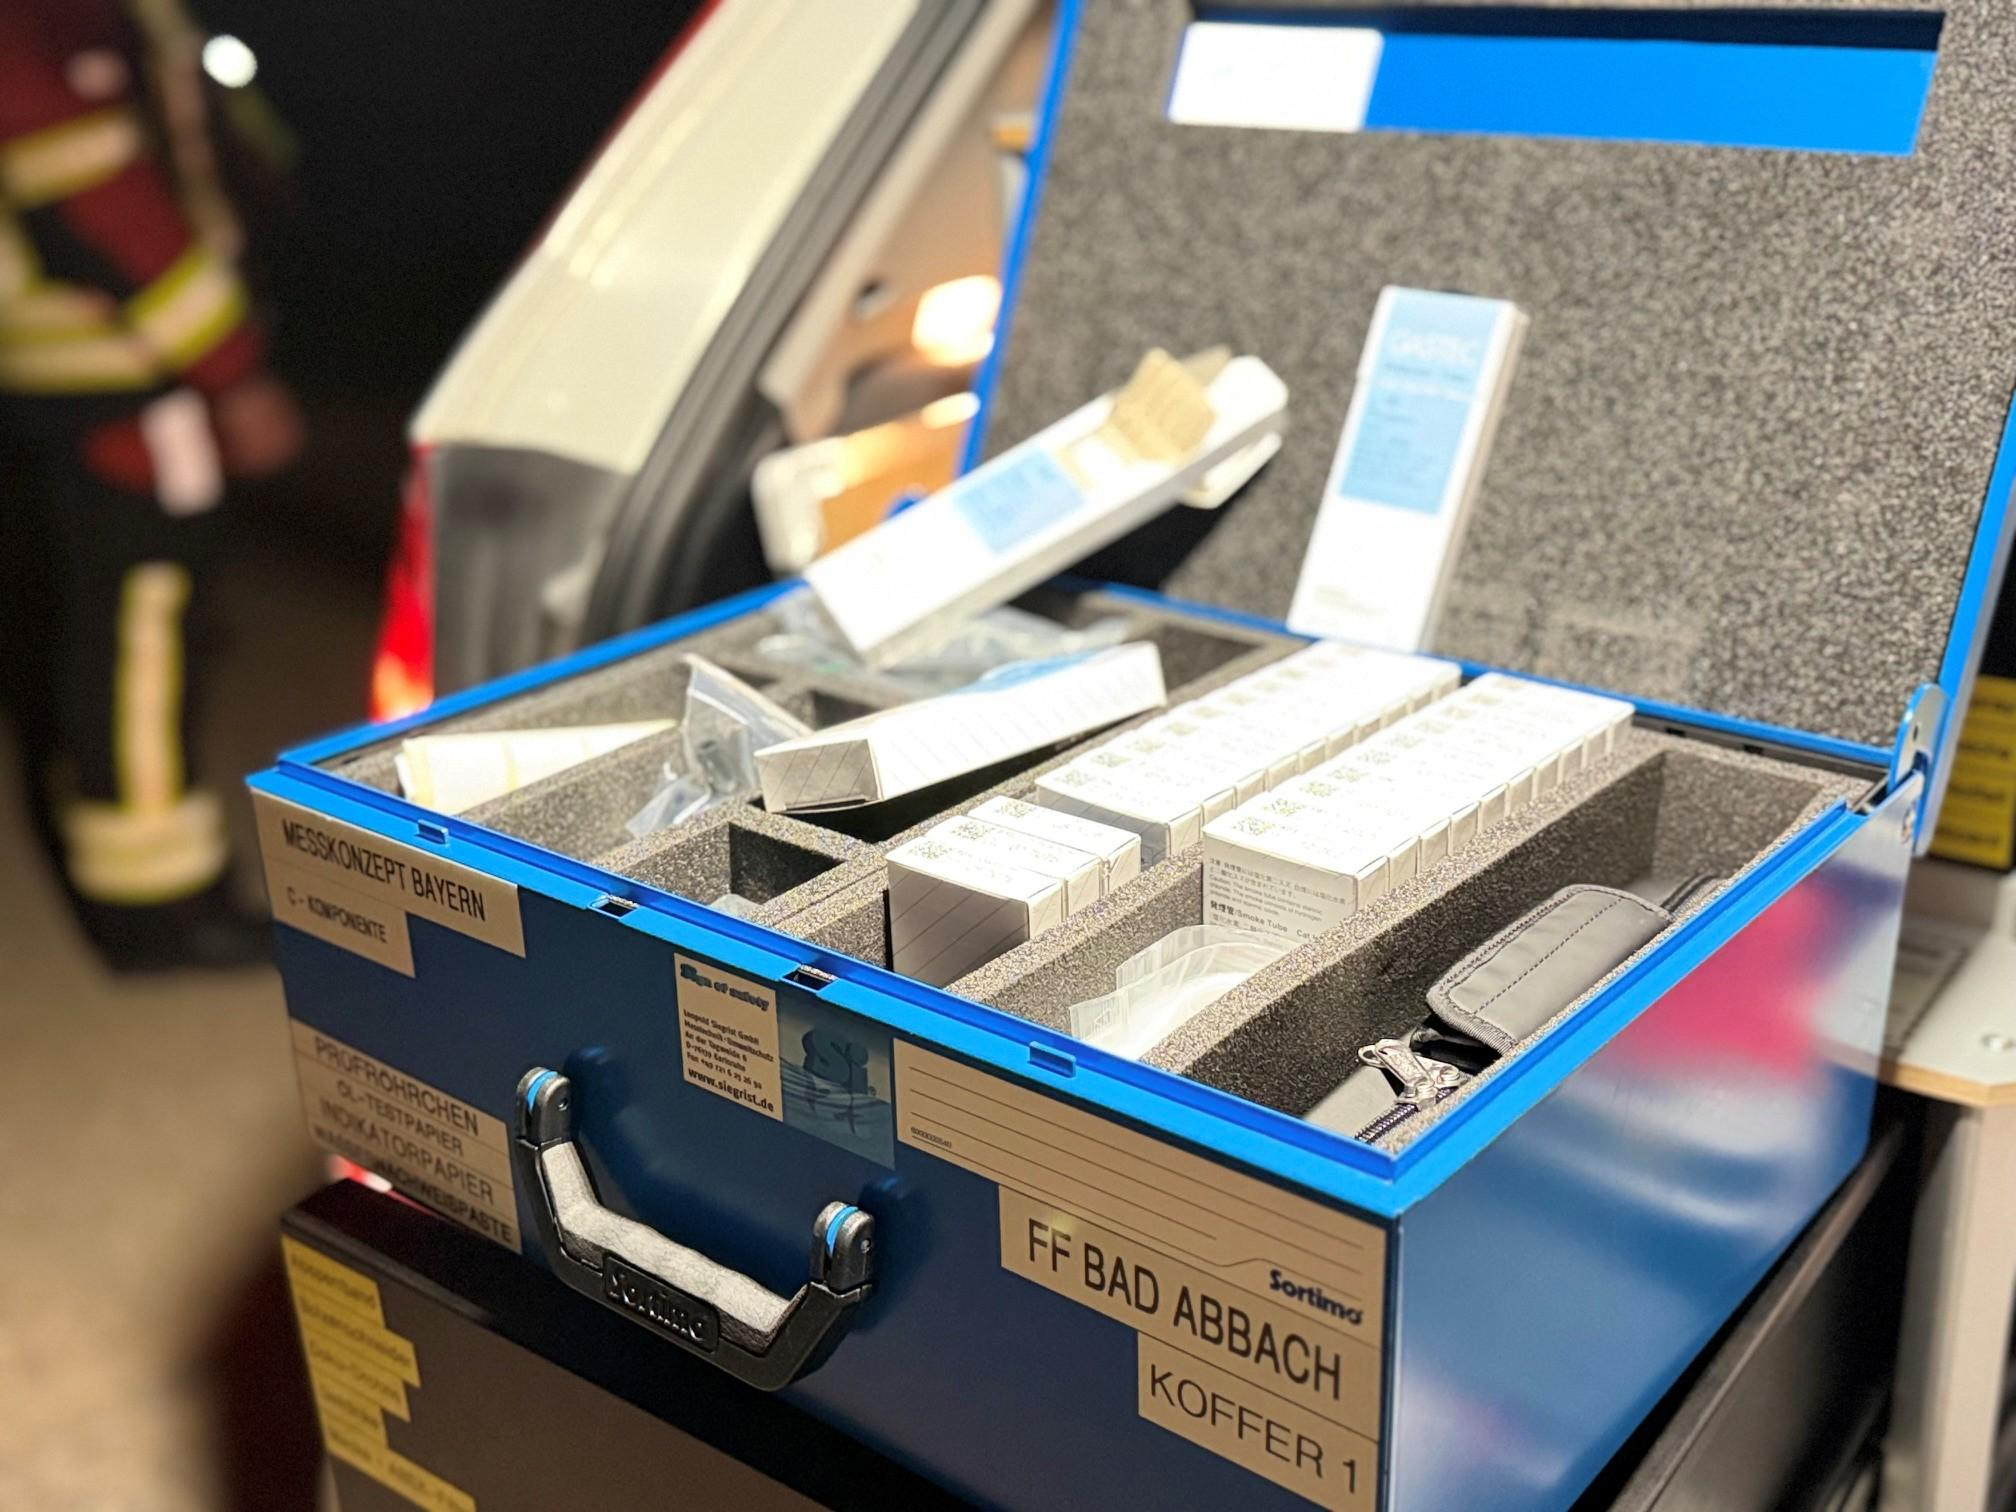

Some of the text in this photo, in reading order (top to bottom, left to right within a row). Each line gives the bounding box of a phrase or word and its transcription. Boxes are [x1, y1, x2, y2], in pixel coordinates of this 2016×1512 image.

[282, 819, 486, 922] MESSKONZEPT BAYERN
[287, 887, 297, 905] C
[307, 894, 388, 943] KOMPONENTE
[688, 1067, 774, 1113] www.siegrist.de
[1028, 1217, 1341, 1400] FF BAD ABBACH
[1269, 1269, 1364, 1326] Sortimo
[1150, 1363, 1356, 1494] KOFFER 1
